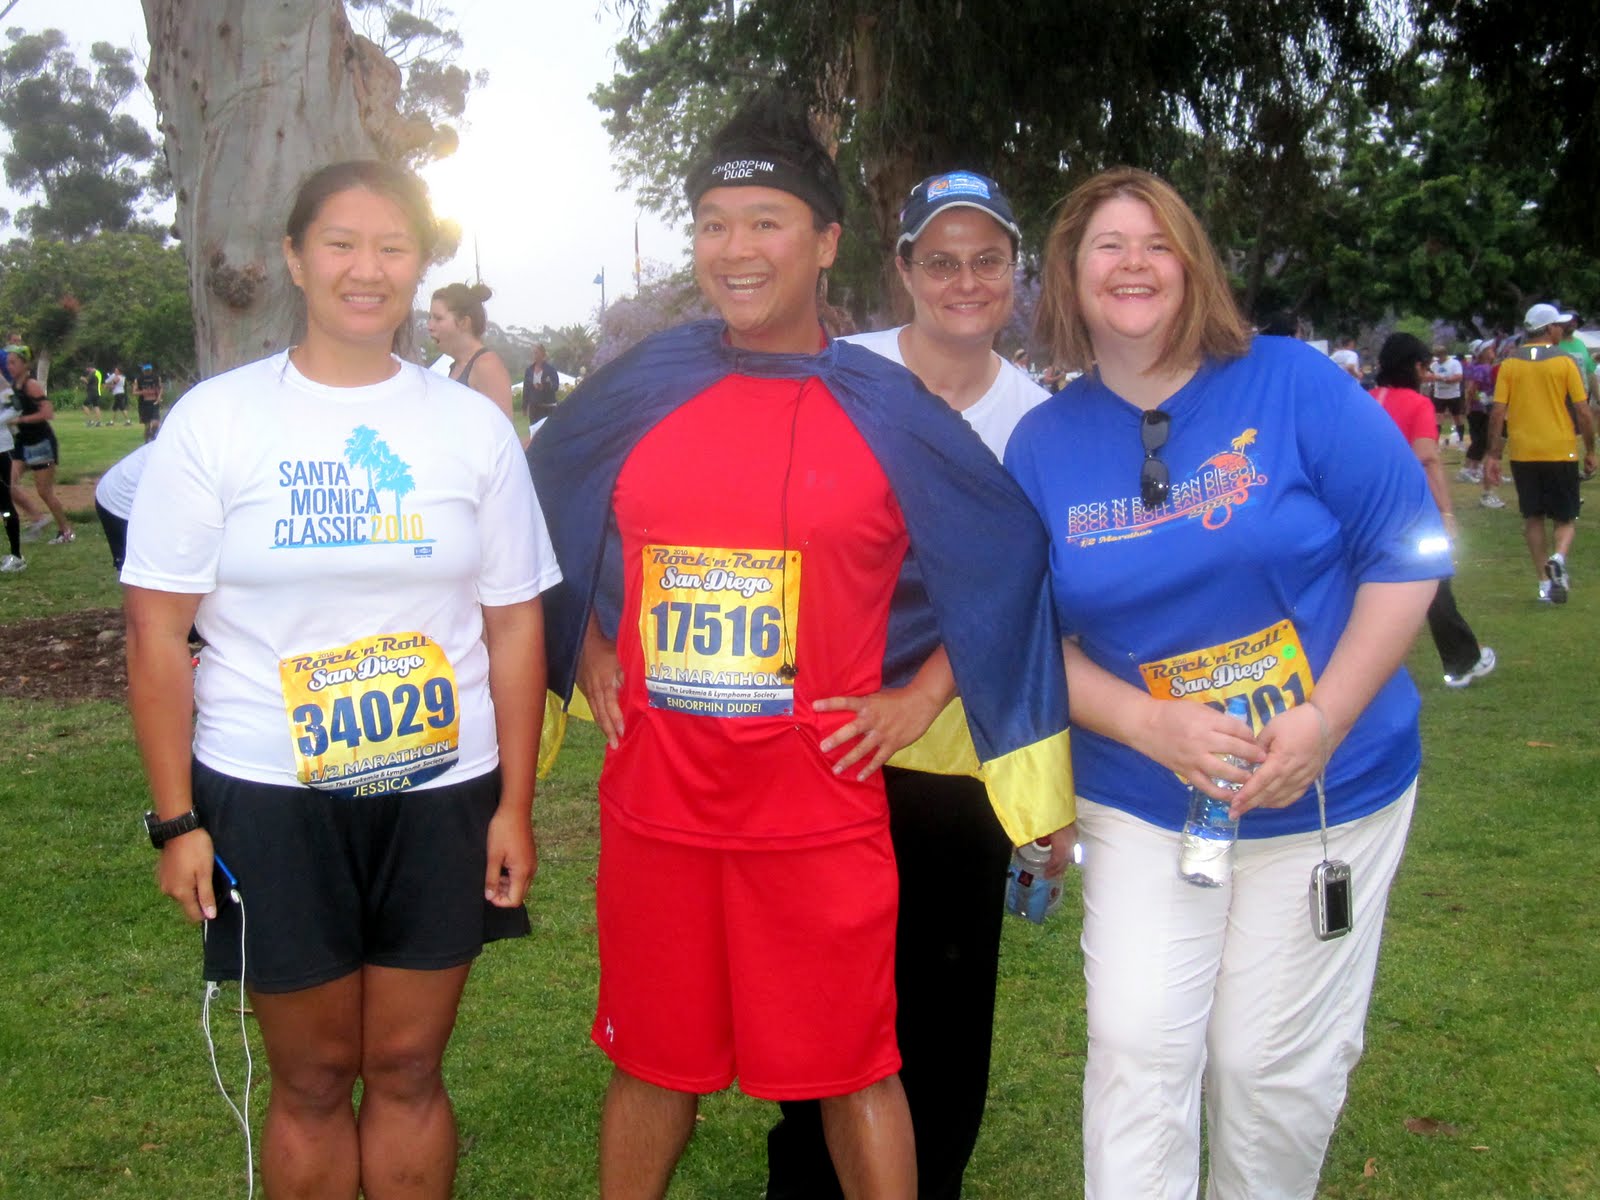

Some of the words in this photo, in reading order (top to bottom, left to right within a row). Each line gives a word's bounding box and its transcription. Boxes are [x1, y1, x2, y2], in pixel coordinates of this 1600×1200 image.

[723, 168, 754, 180] DUDE
[279, 460, 350, 487] SANTA
[291, 488, 381, 516] MONICA
[274, 515, 366, 546] CLASSIC
[370, 513, 424, 542] 2010
[652, 548, 711, 567] Rock
[732, 552, 785, 570] Roll
[660, 566, 703, 590] San
[702, 568, 773, 598] Diego
[650, 600, 782, 658] 17516
[292, 649, 359, 673] Rock
[378, 635, 431, 651] Roll
[318, 651, 334, 659] 2010
[1149, 655, 1212, 680] Rock
[1229, 628, 1284, 660] Roll
[307, 667, 356, 692] San
[354, 653, 425, 681] Diego
[650, 662, 673, 682] 1/2
[675, 668, 783, 688] MARATHON
[1169, 676, 1212, 698] San
[1211, 654, 1278, 689] Diego
[666, 697, 724, 713] ENDORPHIN
[727, 702, 762, 713] DUDE!
[679, 688, 707, 697] Leukemia
[713, 691, 751, 699] Lymphoma
[753, 691, 777, 699] Society
[292, 676, 456, 757] 34029
[310, 765, 340, 782] 1/2
[344, 739, 450, 776] MARATHON
[348, 774, 379, 785] Leukemia
[386, 764, 421, 777] Lymphoma
[422, 757, 445, 768] Society
[353, 776, 412, 798] JESSICA
